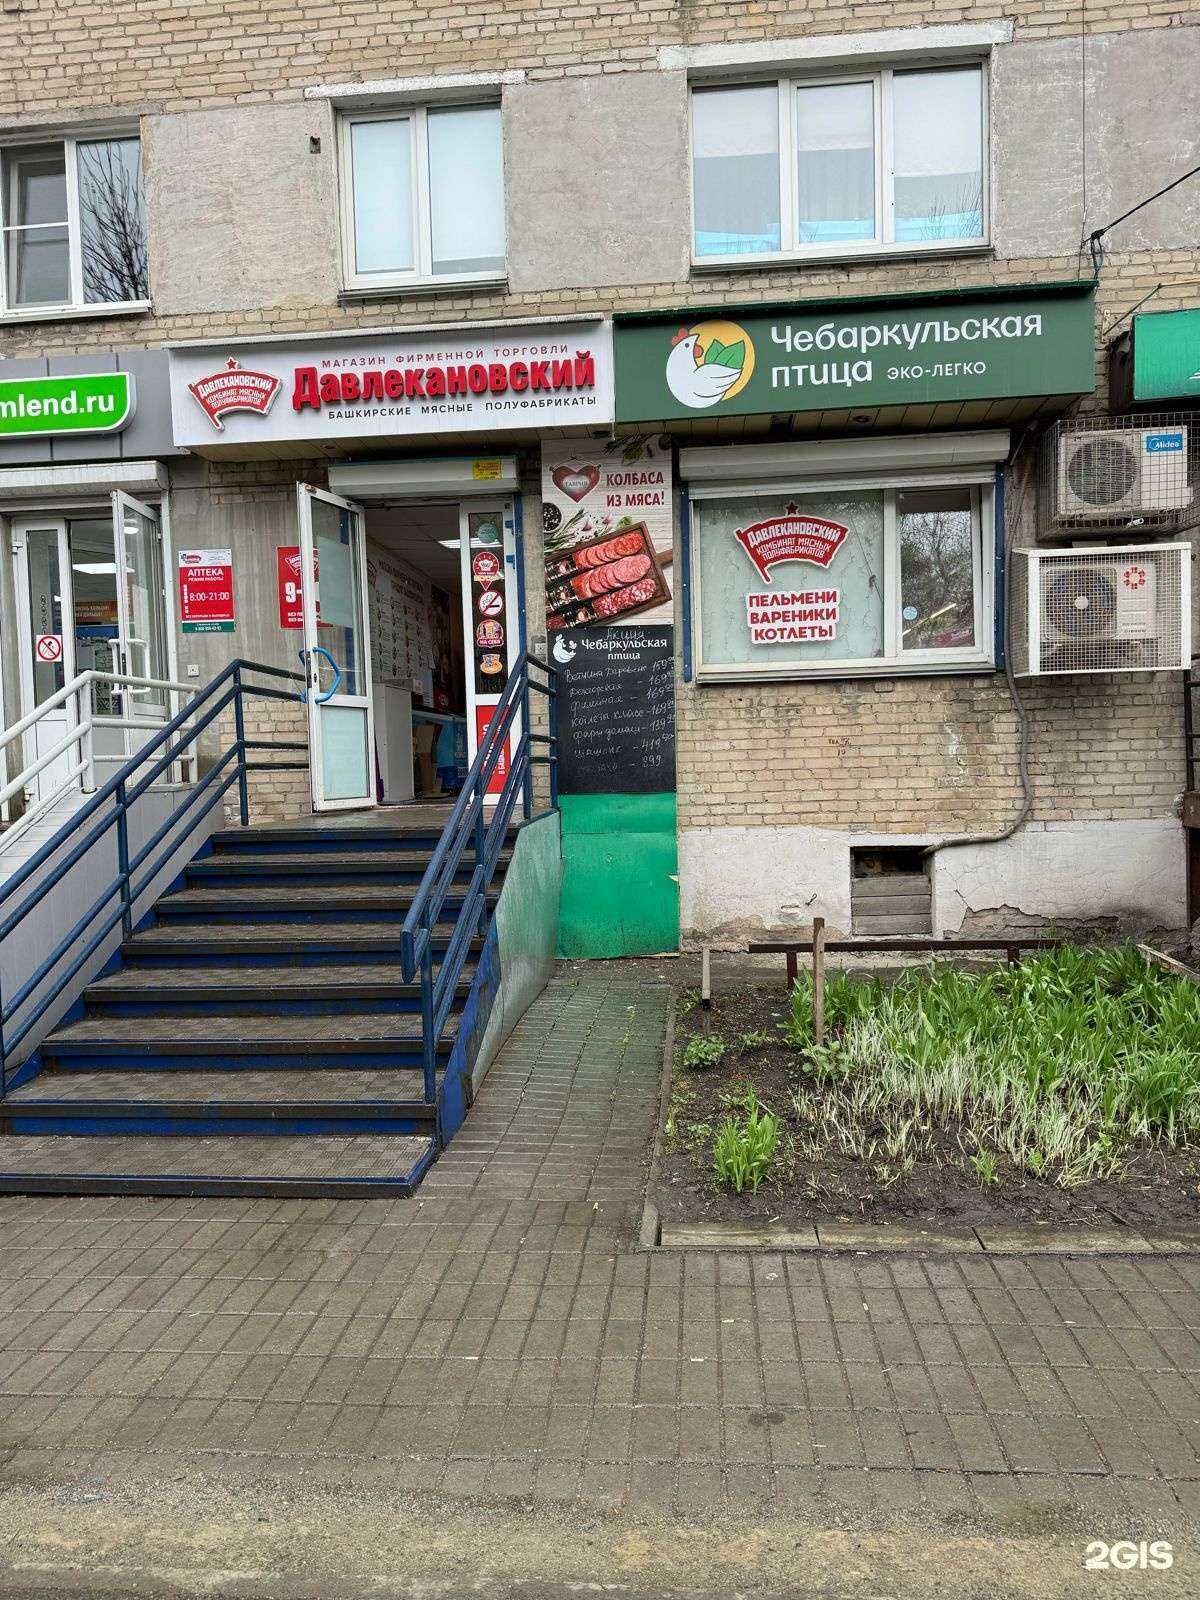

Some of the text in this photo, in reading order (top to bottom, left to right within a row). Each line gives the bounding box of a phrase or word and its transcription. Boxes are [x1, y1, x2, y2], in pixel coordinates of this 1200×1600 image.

[771, 313, 1043, 353] Чебаркульская
[322, 345, 569, 368] МАГАЗИН ФИРМЕННОЙ ТОРГОВЛИ
[292, 351, 596, 411] Давлекановский
[772, 360, 986, 388] птица ЭКО-ЛЕГКО
[328, 397, 597, 419] БАШКИРСКИЕ МЯСНЫЕ ПОЛУФАБРИКАТЫ
[606, 472, 664, 486] КОЛБАСА
[607, 491, 665, 507] ИЗ МЯСА!
[747, 522, 841, 548] ДАВЛЕКАНОВСКИЙ
[756, 537, 831, 555] КОМБИНАТ МЯСНЫХ
[762, 546, 824, 560] ПОЛУФАБРИКАТОВ
[188, 568, 224, 577] АПТЕКА
[749, 591, 837, 607] ПЕЛЬМЕНИ
[750, 608, 836, 624] ВАРЕНИКИ
[754, 625, 833, 641] КОТЛЕТЫ
[581, 639, 667, 651] Чебаркульская
[607, 652, 641, 660] птица
